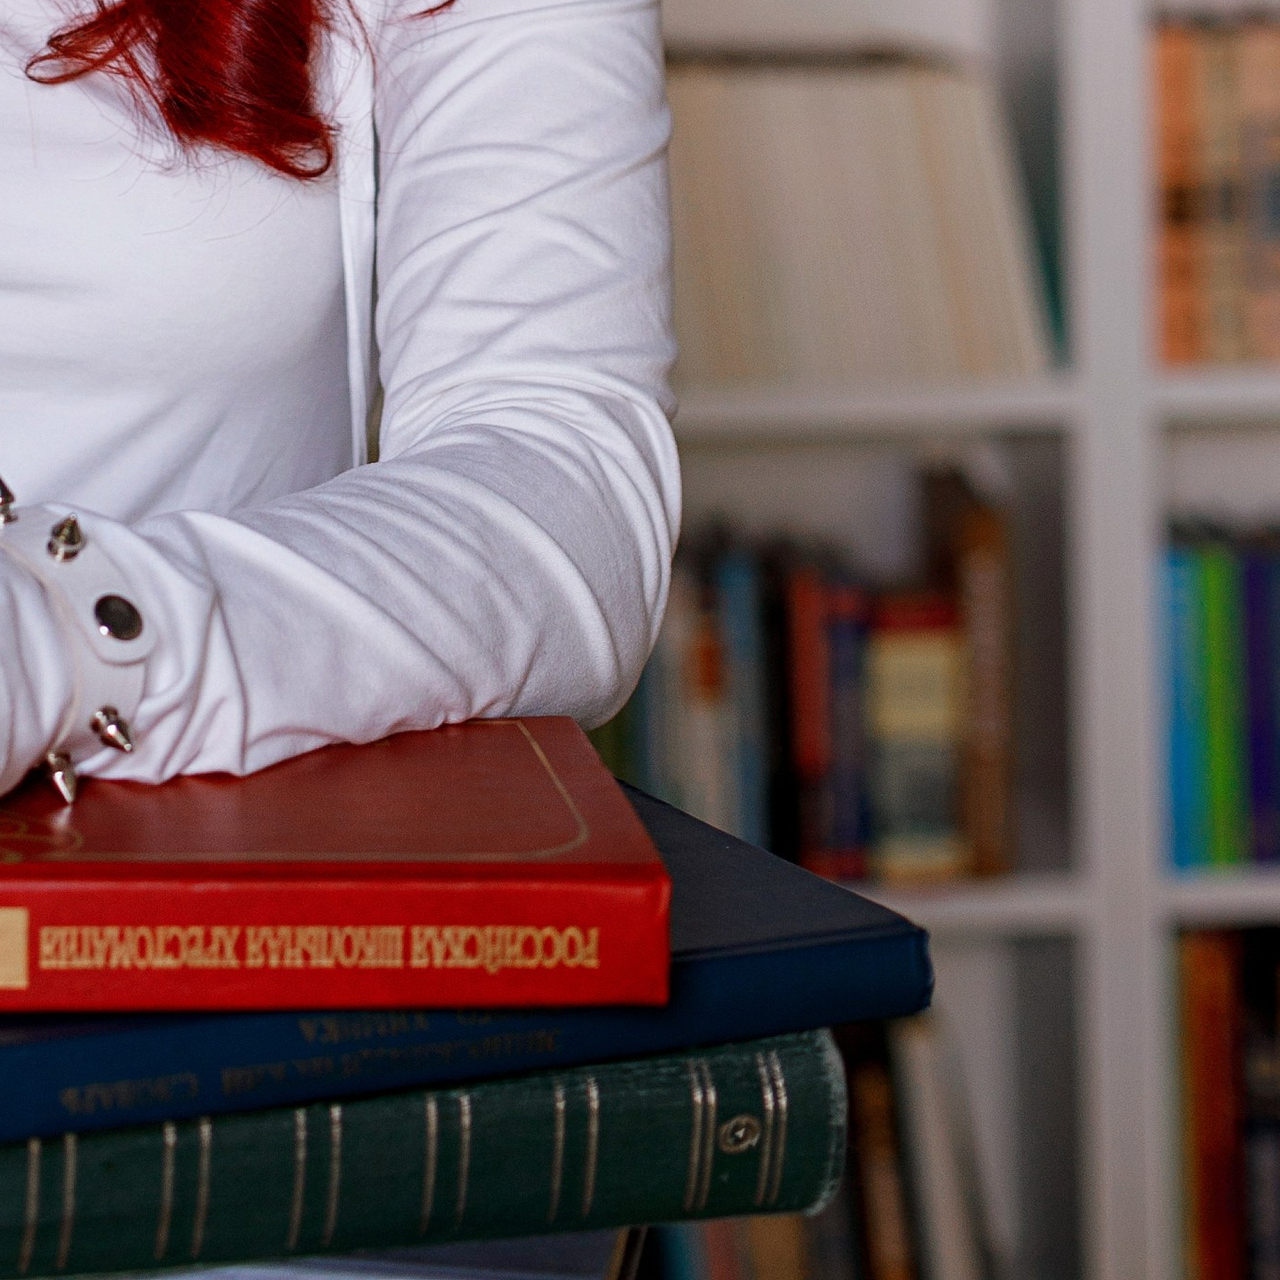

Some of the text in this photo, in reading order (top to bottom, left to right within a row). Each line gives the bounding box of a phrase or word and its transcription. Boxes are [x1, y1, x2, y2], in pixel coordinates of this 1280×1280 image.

[39, 926, 242, 972] ХРЕСТОМАТИЯ
[247, 926, 405, 970] ШКОЛЬНАЯ
[411, 926, 600, 975] РОССИЙСКАЯ
